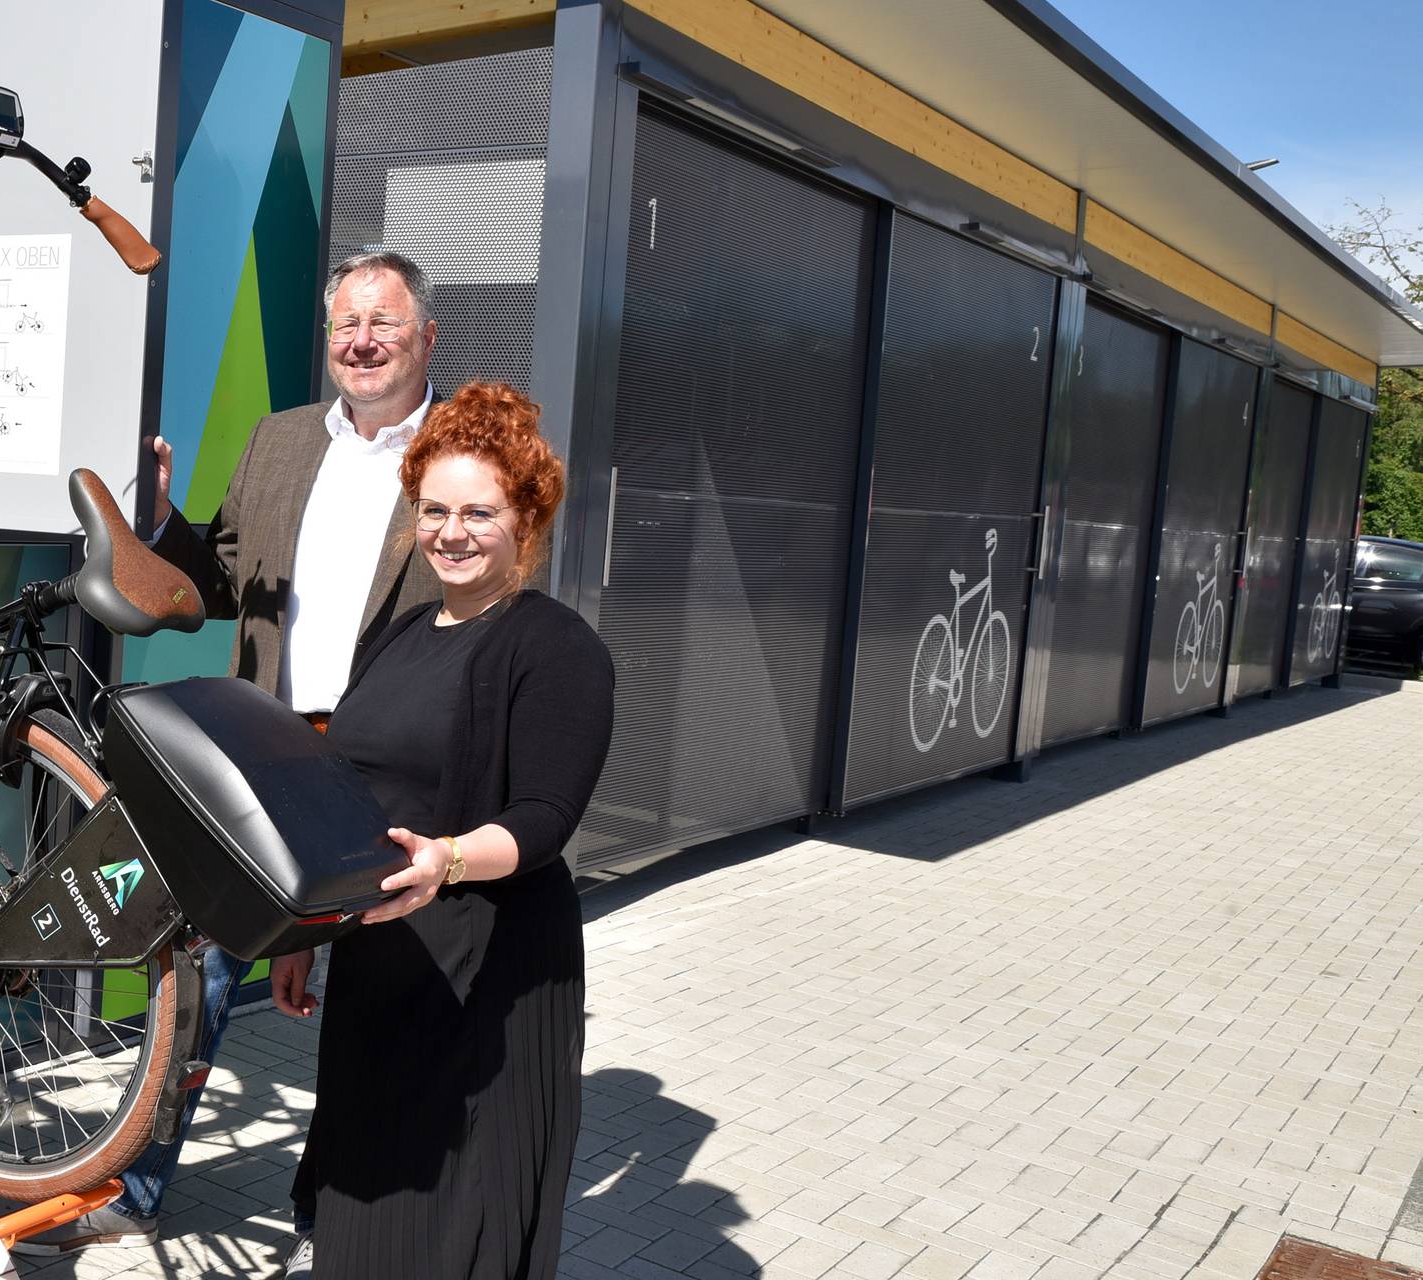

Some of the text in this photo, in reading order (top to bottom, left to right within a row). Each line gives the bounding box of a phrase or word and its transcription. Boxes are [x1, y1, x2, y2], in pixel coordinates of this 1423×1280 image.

[648, 198, 657, 250] 1
[16, 246, 60, 267] OBEN
[1030, 326, 1040, 362] 2
[1242, 401, 1249, 426] 4
[60, 866, 111, 948] DienstRad
[91, 870, 120, 916] ARNSBERG
[37, 913, 53, 930] 2
